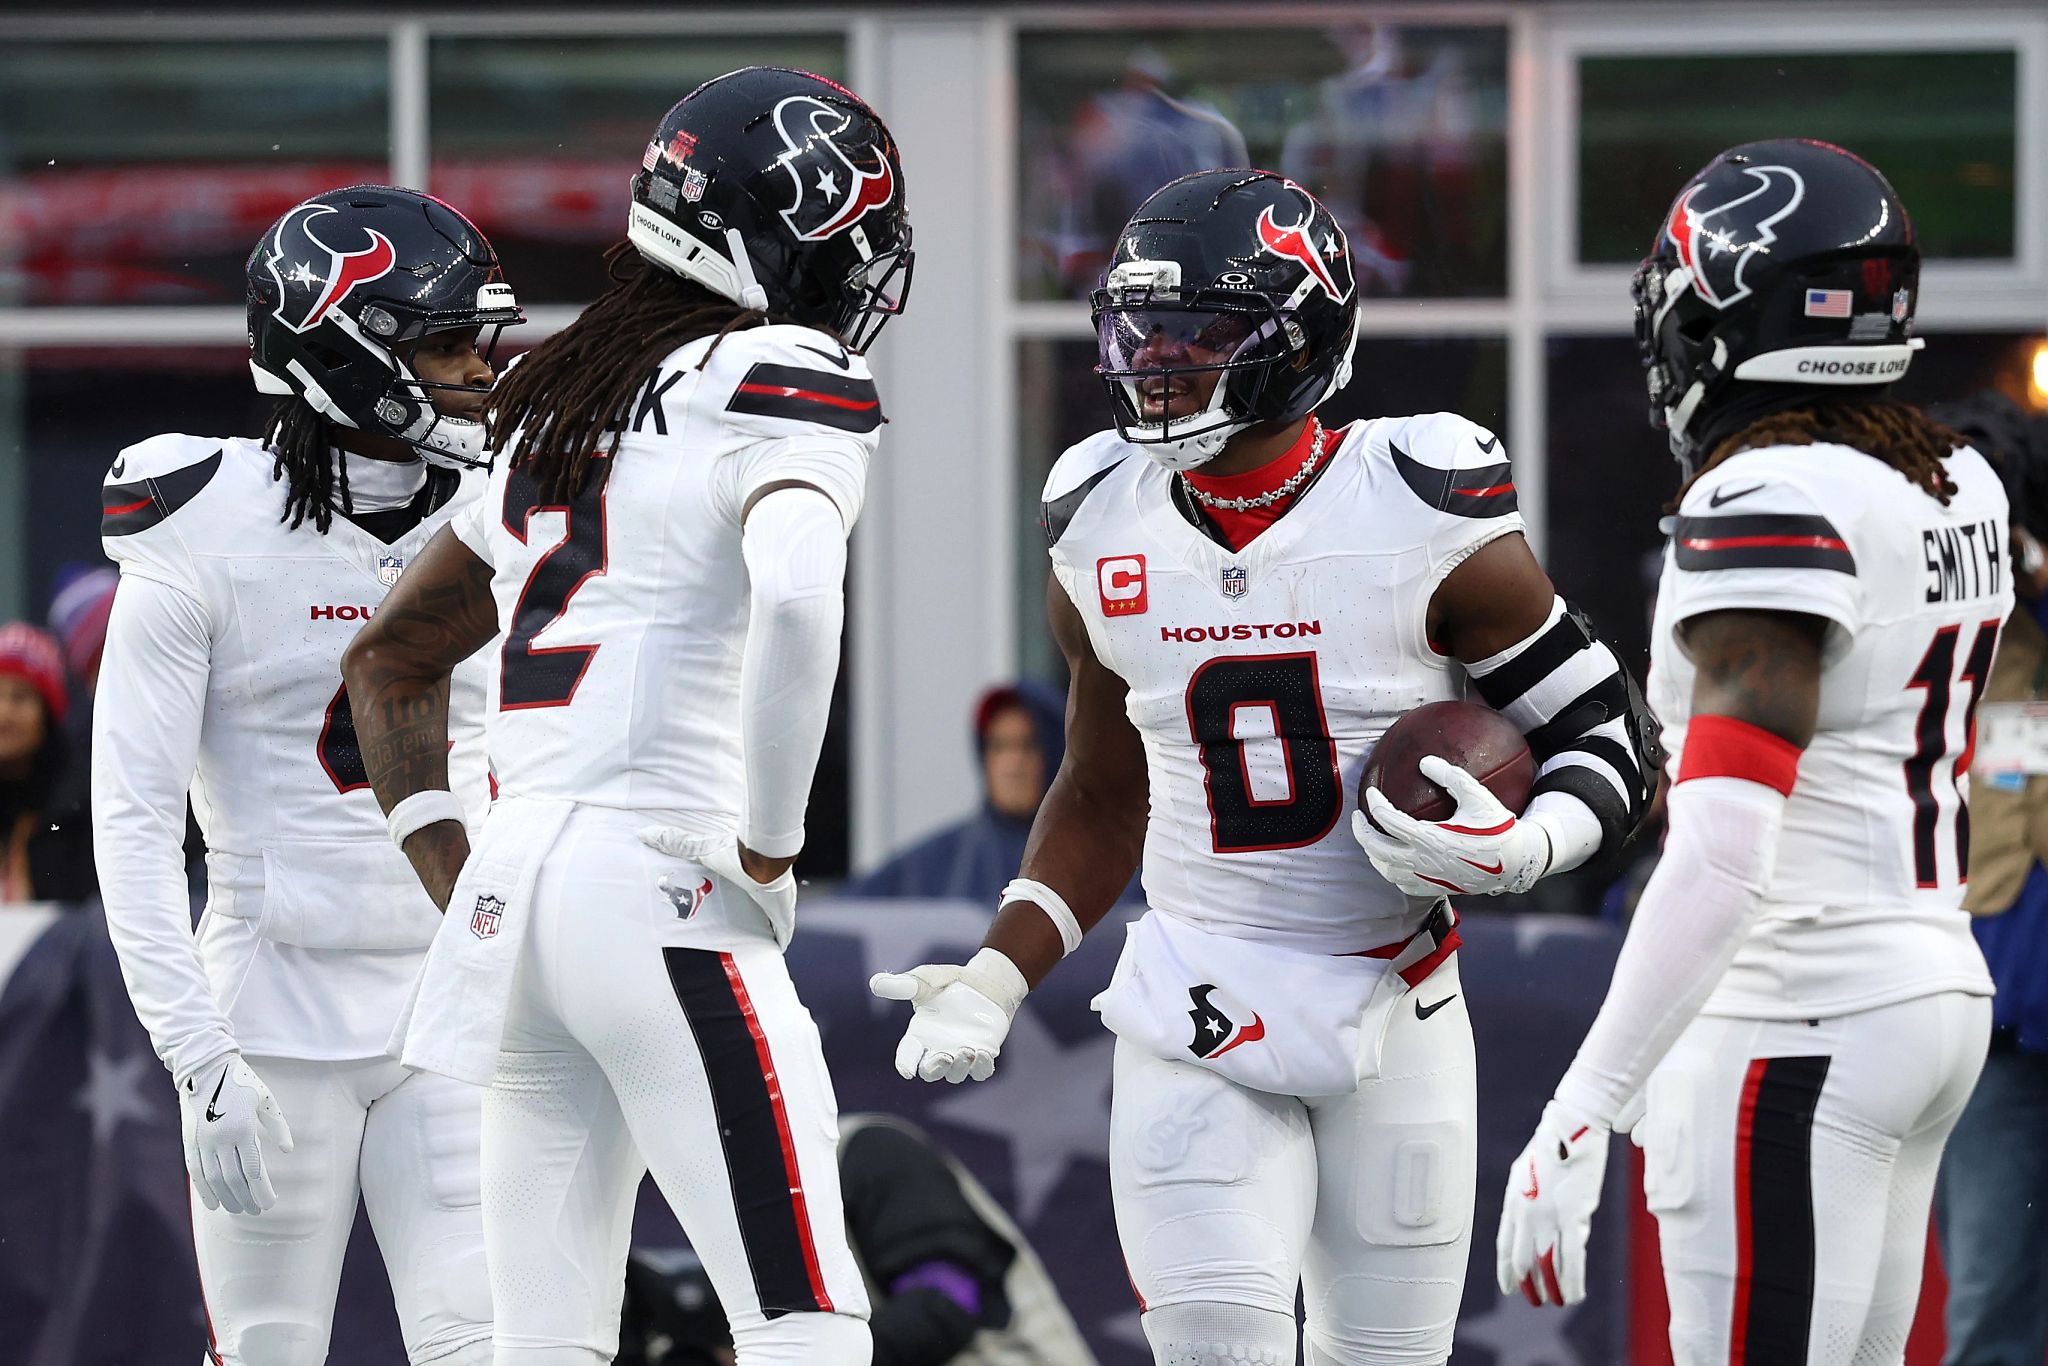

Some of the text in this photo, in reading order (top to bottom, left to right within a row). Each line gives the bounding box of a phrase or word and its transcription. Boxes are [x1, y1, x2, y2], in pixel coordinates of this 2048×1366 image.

[683, 182, 700, 198] NFL
[636, 215, 682, 248] CHOOSE LOVE
[1797, 359, 1907, 375] CHOOSE LOVE
[1922, 519, 2001, 604] SMITH
[500, 451, 608, 713] 2
[1100, 558, 1142, 601] C
[1224, 579, 1246, 594] NFL
[1160, 620, 1322, 643] HOUSTON
[1185, 650, 1344, 854] 0
[1903, 617, 2001, 890] 11
[472, 911, 497, 935] NFL
